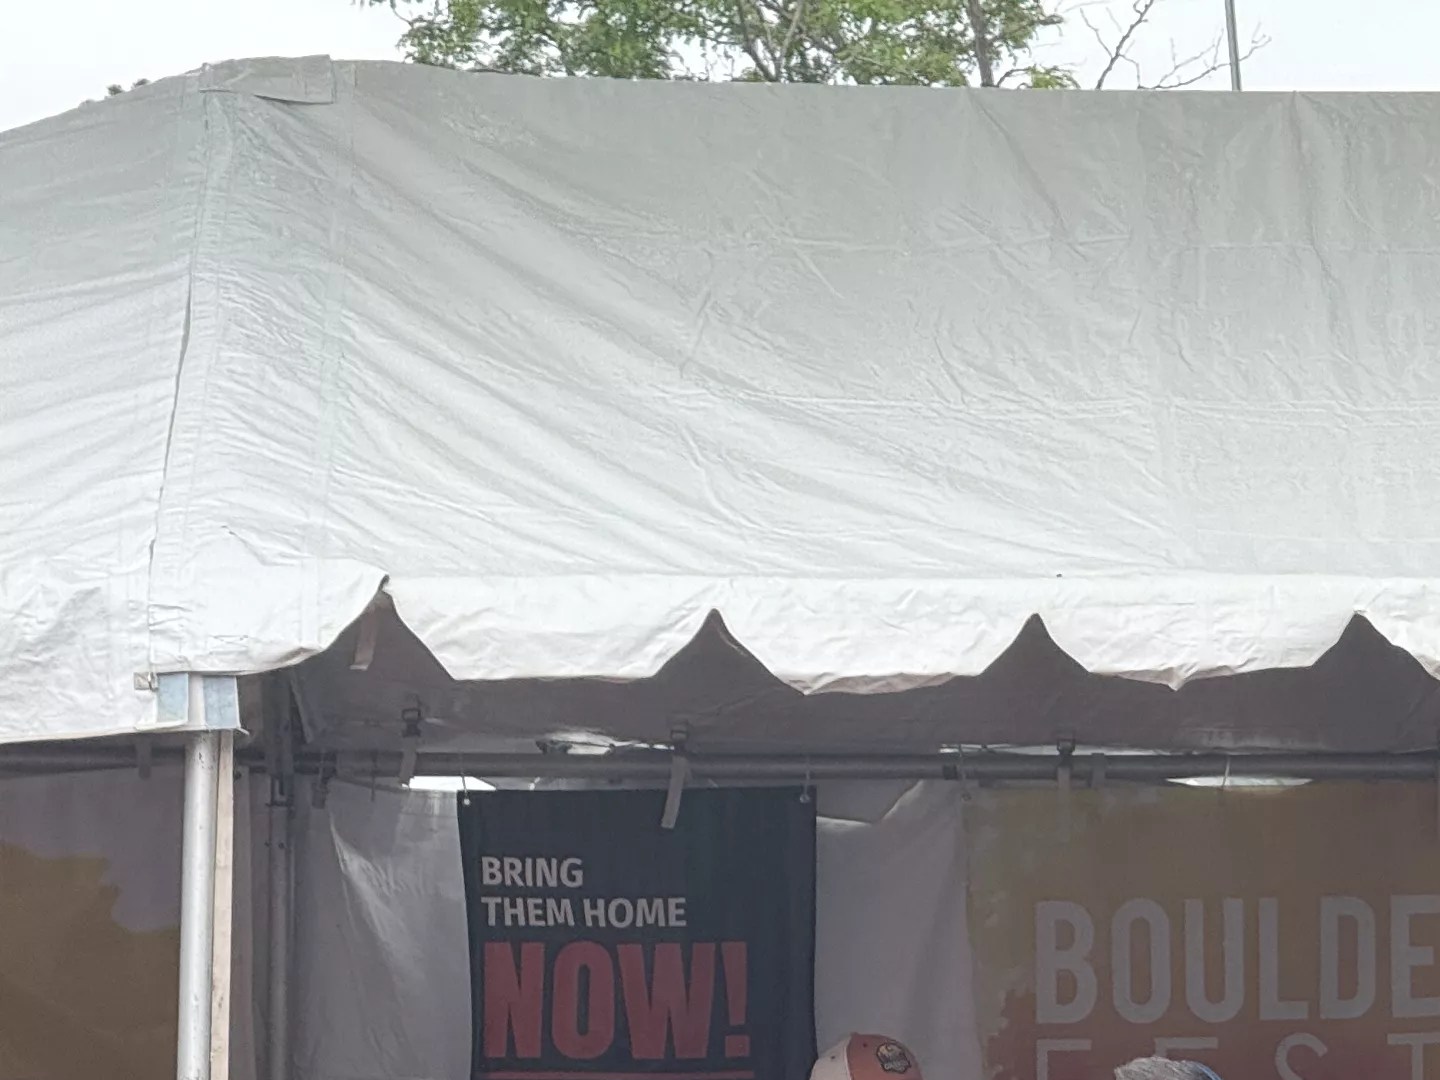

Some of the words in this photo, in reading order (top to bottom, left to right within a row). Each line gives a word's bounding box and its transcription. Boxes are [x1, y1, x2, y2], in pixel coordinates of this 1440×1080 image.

[481, 856, 584, 888] BRING
[481, 896, 575, 927] THEM
[583, 897, 688, 928] HOME
[483, 940, 751, 1061] NOW!
